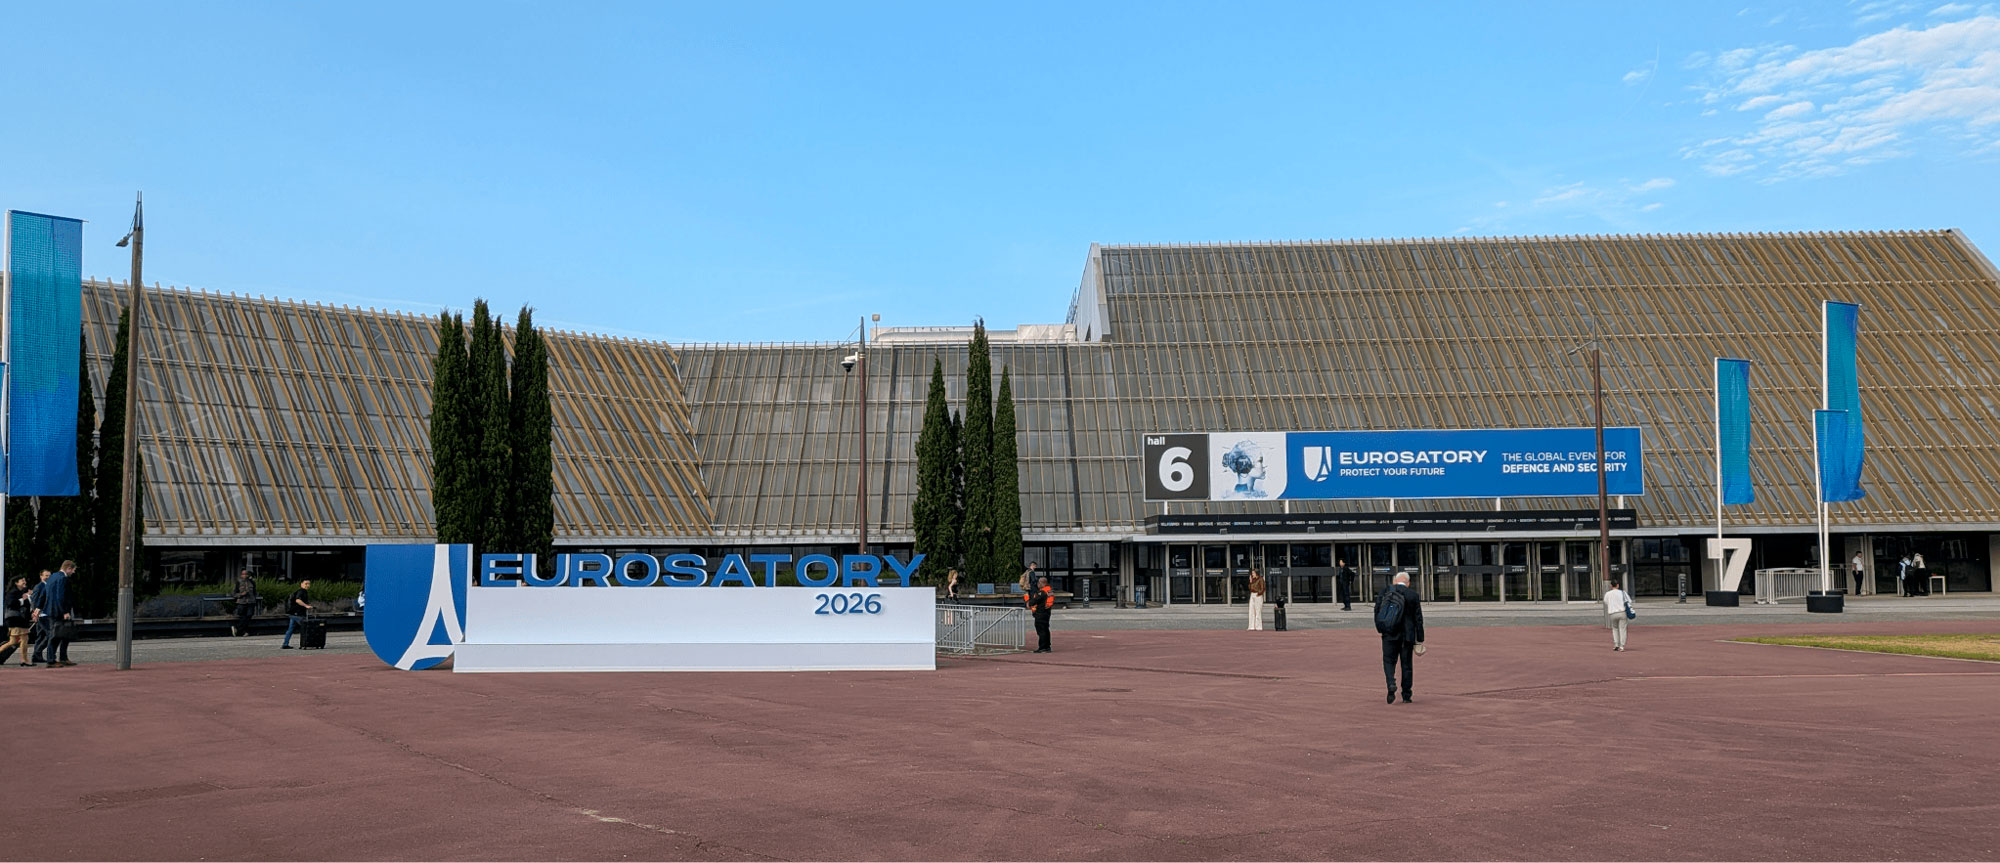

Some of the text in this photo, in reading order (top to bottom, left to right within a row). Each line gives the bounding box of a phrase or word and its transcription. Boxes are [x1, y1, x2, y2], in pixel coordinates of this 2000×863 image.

[1147, 436, 1166, 445] hall
[1339, 450, 1488, 465] EUROSATORY
[1502, 451, 1626, 461] THE GLOBAL EVEN FOR
[1159, 446, 1194, 492] 6
[1340, 467, 1445, 476] PROTECT YOUR FUTURE
[1502, 462, 1627, 473] DEFENCE AND SECRITY
[481, 553, 926, 587] EUROSATORY
[1707, 538, 1752, 592] 7
[814, 593, 882, 615] 2026
